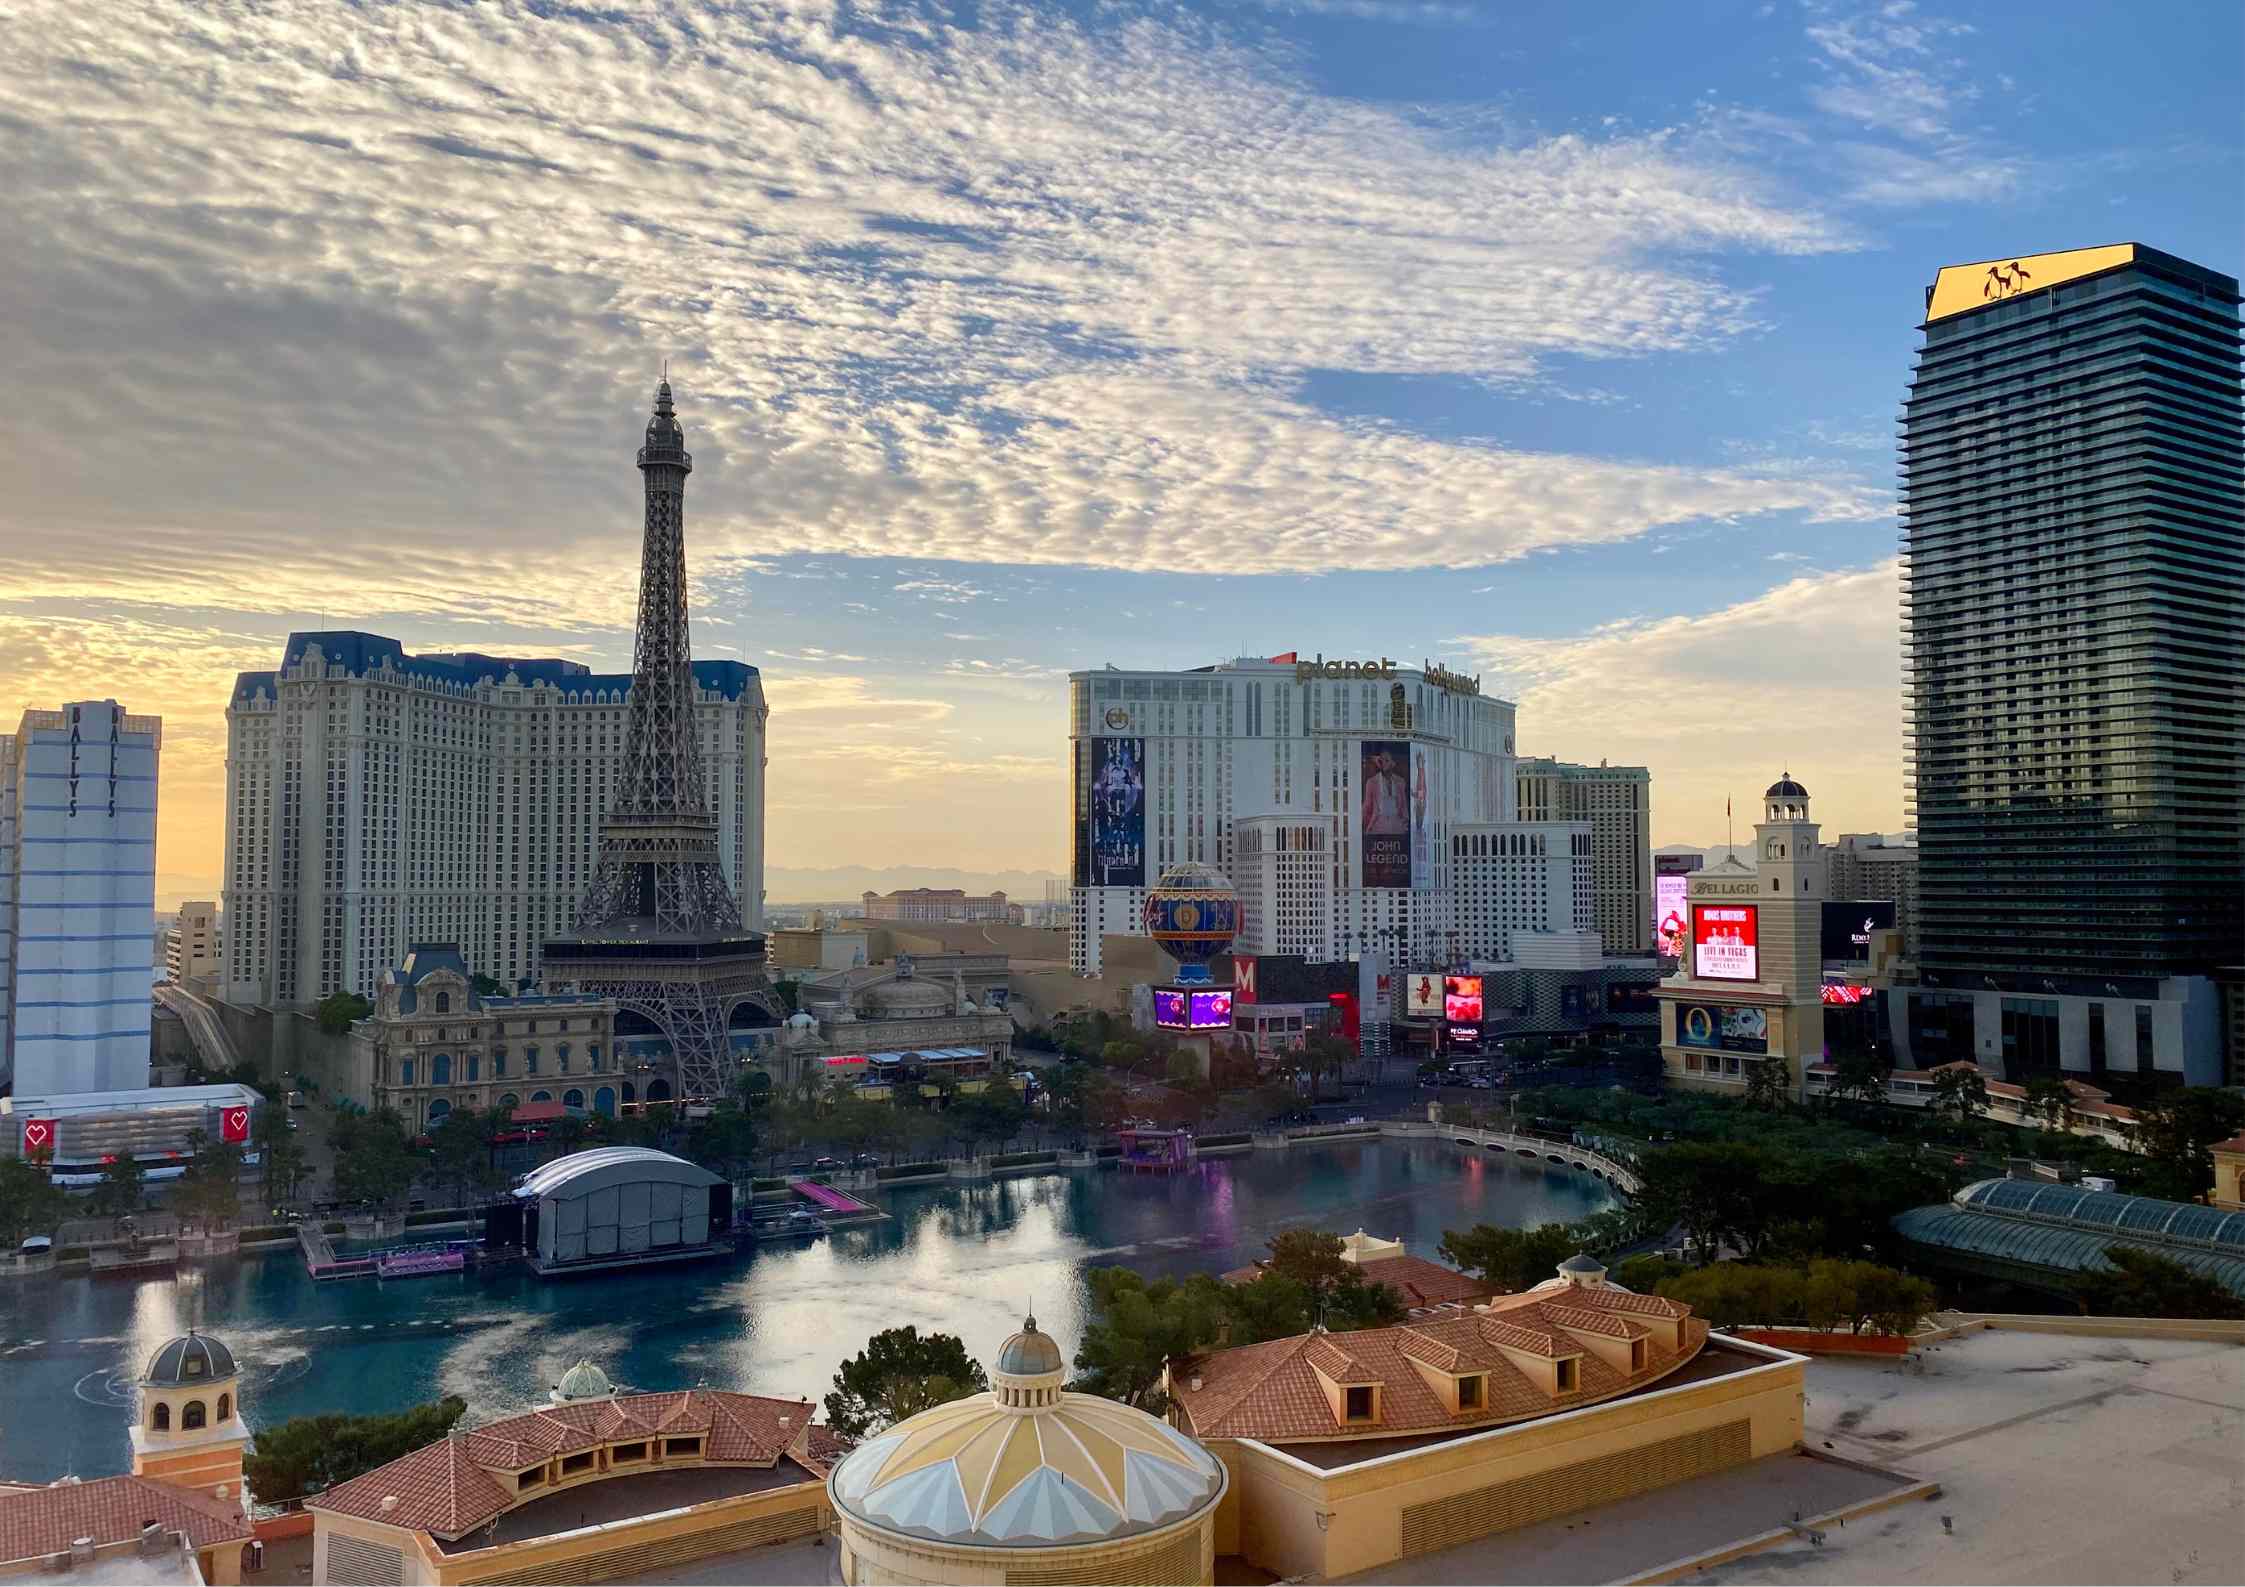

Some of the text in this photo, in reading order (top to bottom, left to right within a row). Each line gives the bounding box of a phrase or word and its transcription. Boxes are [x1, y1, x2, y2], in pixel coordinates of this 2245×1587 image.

[1296, 653, 1397, 685] planet
[1372, 841, 1400, 852] JOHN
[1366, 854, 1408, 864] LEGEND
[1694, 882, 1759, 896] BELLAGIO
[1235, 961, 1254, 993] M
[1684, 1007, 1713, 1041] O
